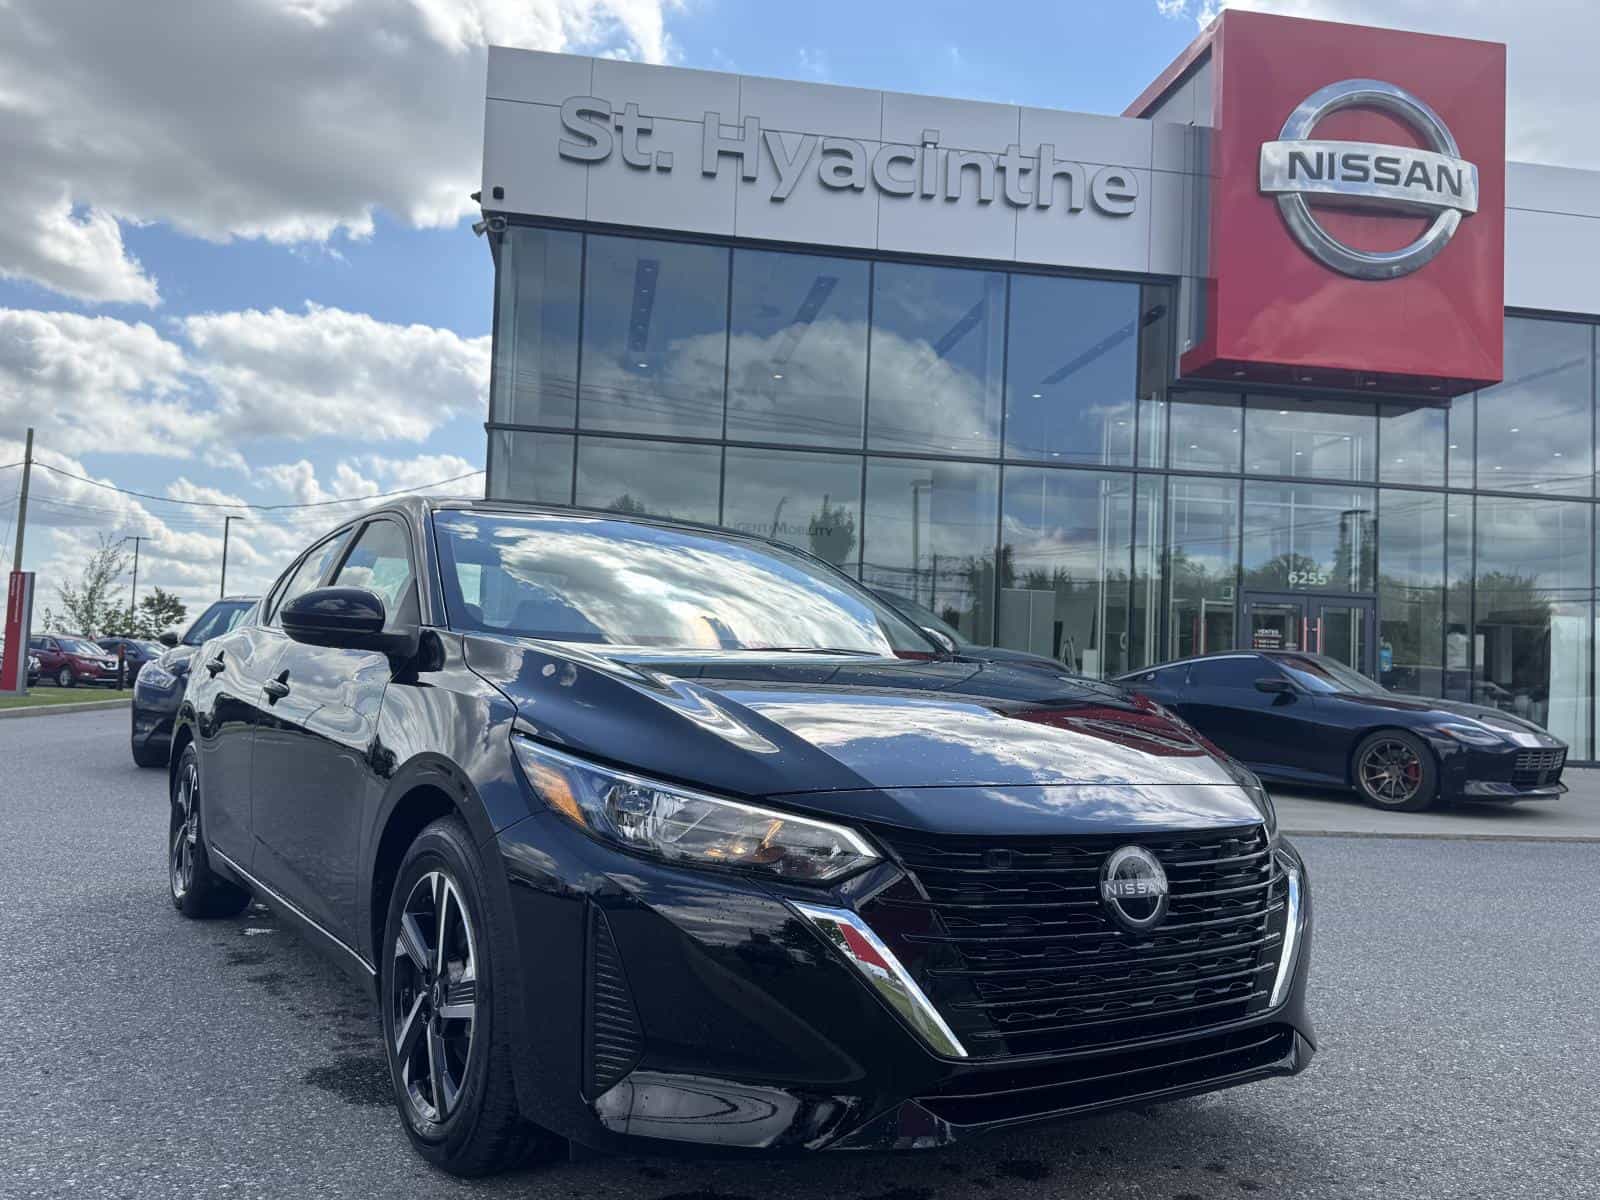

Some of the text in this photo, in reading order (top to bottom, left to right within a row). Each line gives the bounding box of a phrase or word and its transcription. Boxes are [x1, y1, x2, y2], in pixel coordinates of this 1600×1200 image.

[559, 96, 1139, 217] St. Hyacinthe
[1288, 151, 1462, 197] NISSAN
[1288, 571, 1327, 584] 6255
[1105, 882, 1168, 895] NISSAN
